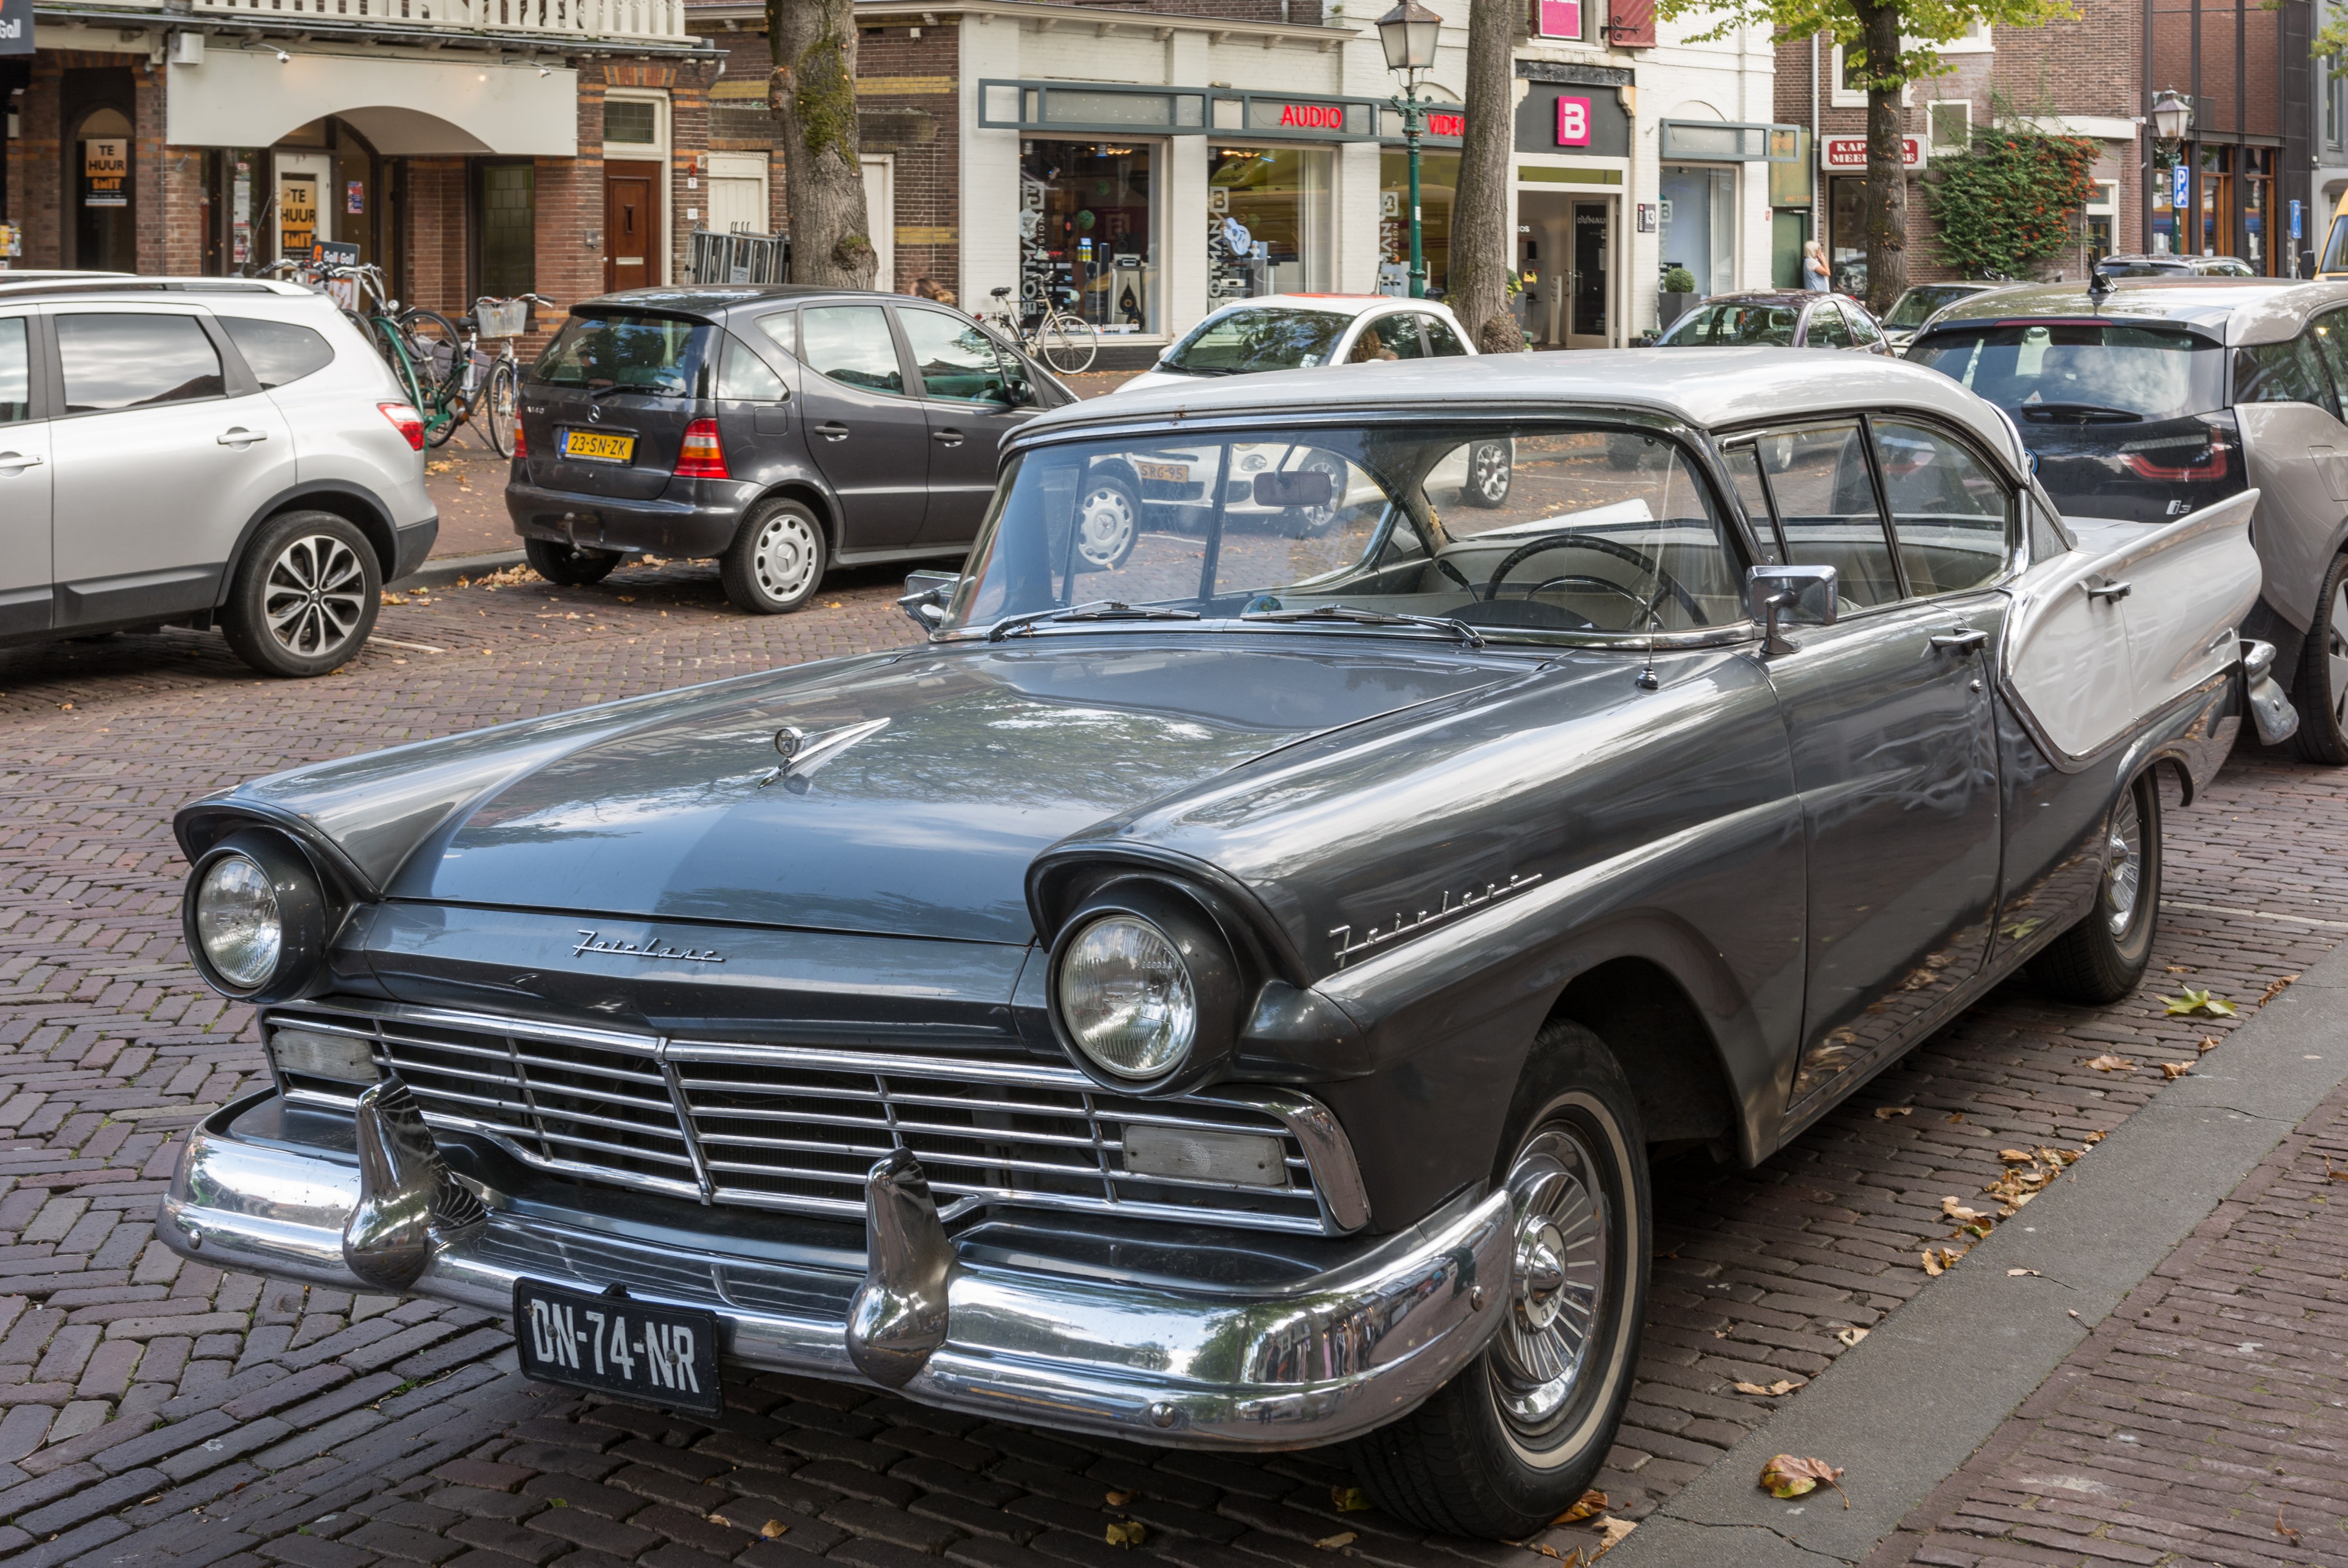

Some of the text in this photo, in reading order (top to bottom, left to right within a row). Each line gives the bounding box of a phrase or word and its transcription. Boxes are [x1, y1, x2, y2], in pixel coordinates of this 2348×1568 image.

[1280, 104, 1342, 129] AUDIO
[1564, 103, 1586, 138] B
[99, 144, 114, 156] TE
[1836, 142, 1910, 152] KAPN
[88, 159, 125, 171] HUUR
[2177, 170, 2186, 191] P
[291, 188, 306, 203] TE
[281, 208, 316, 222] HUUR
[1644, 209, 1655, 225] 13
[1661, 203, 1670, 219] B
[1577, 215, 1606, 224] DYNAU
[570, 435, 626, 457] 23-SN-ZK
[1141, 465, 1183, 480] SRG-95
[2166, 499, 2192, 515] i3
[1328, 873, 1543, 968] Fairlane
[572, 928, 726, 962] Fairlane
[530, 1298, 700, 1394] DN-74-NR
